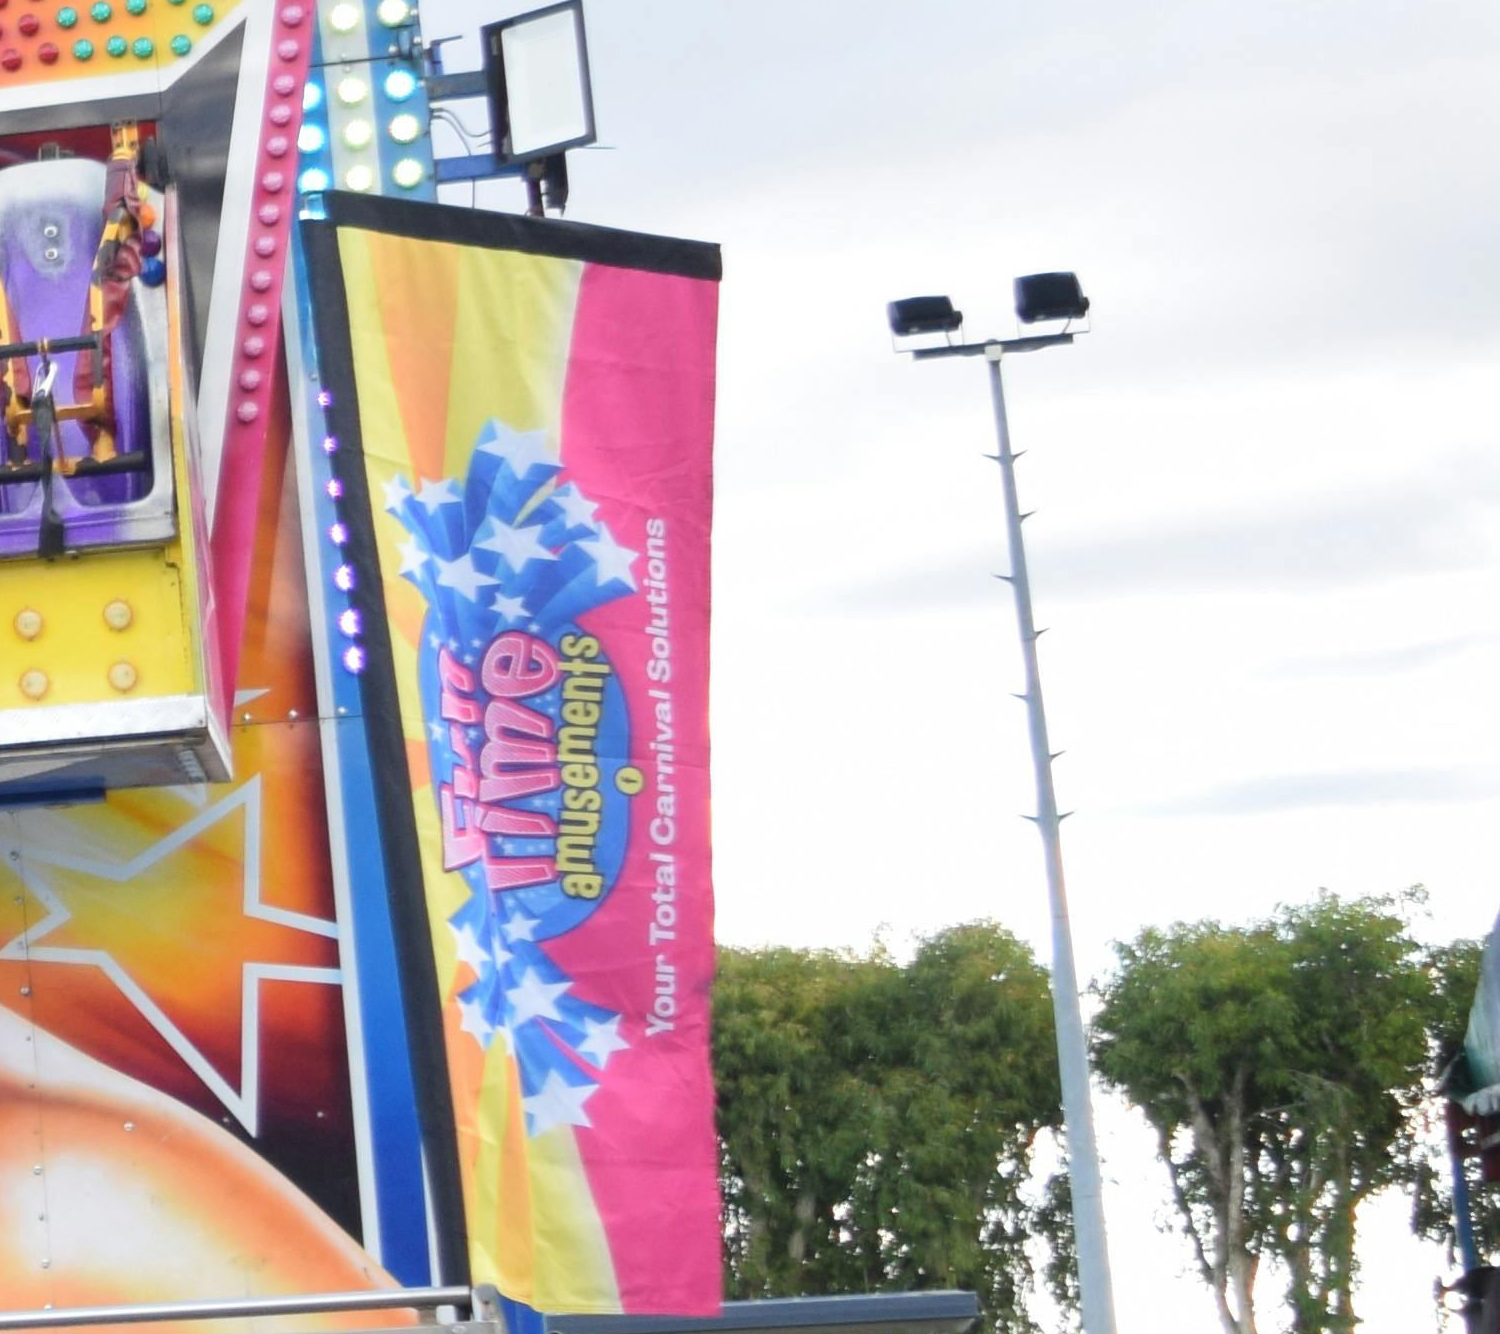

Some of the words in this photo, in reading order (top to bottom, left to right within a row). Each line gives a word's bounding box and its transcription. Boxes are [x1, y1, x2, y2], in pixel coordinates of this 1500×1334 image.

[644, 518, 671, 684] Solutions
[479, 629, 560, 894] Time
[555, 633, 611, 902] amusements
[648, 688, 677, 846] Carnival
[649, 852, 677, 946] Total
[645, 954, 677, 1037] Your
